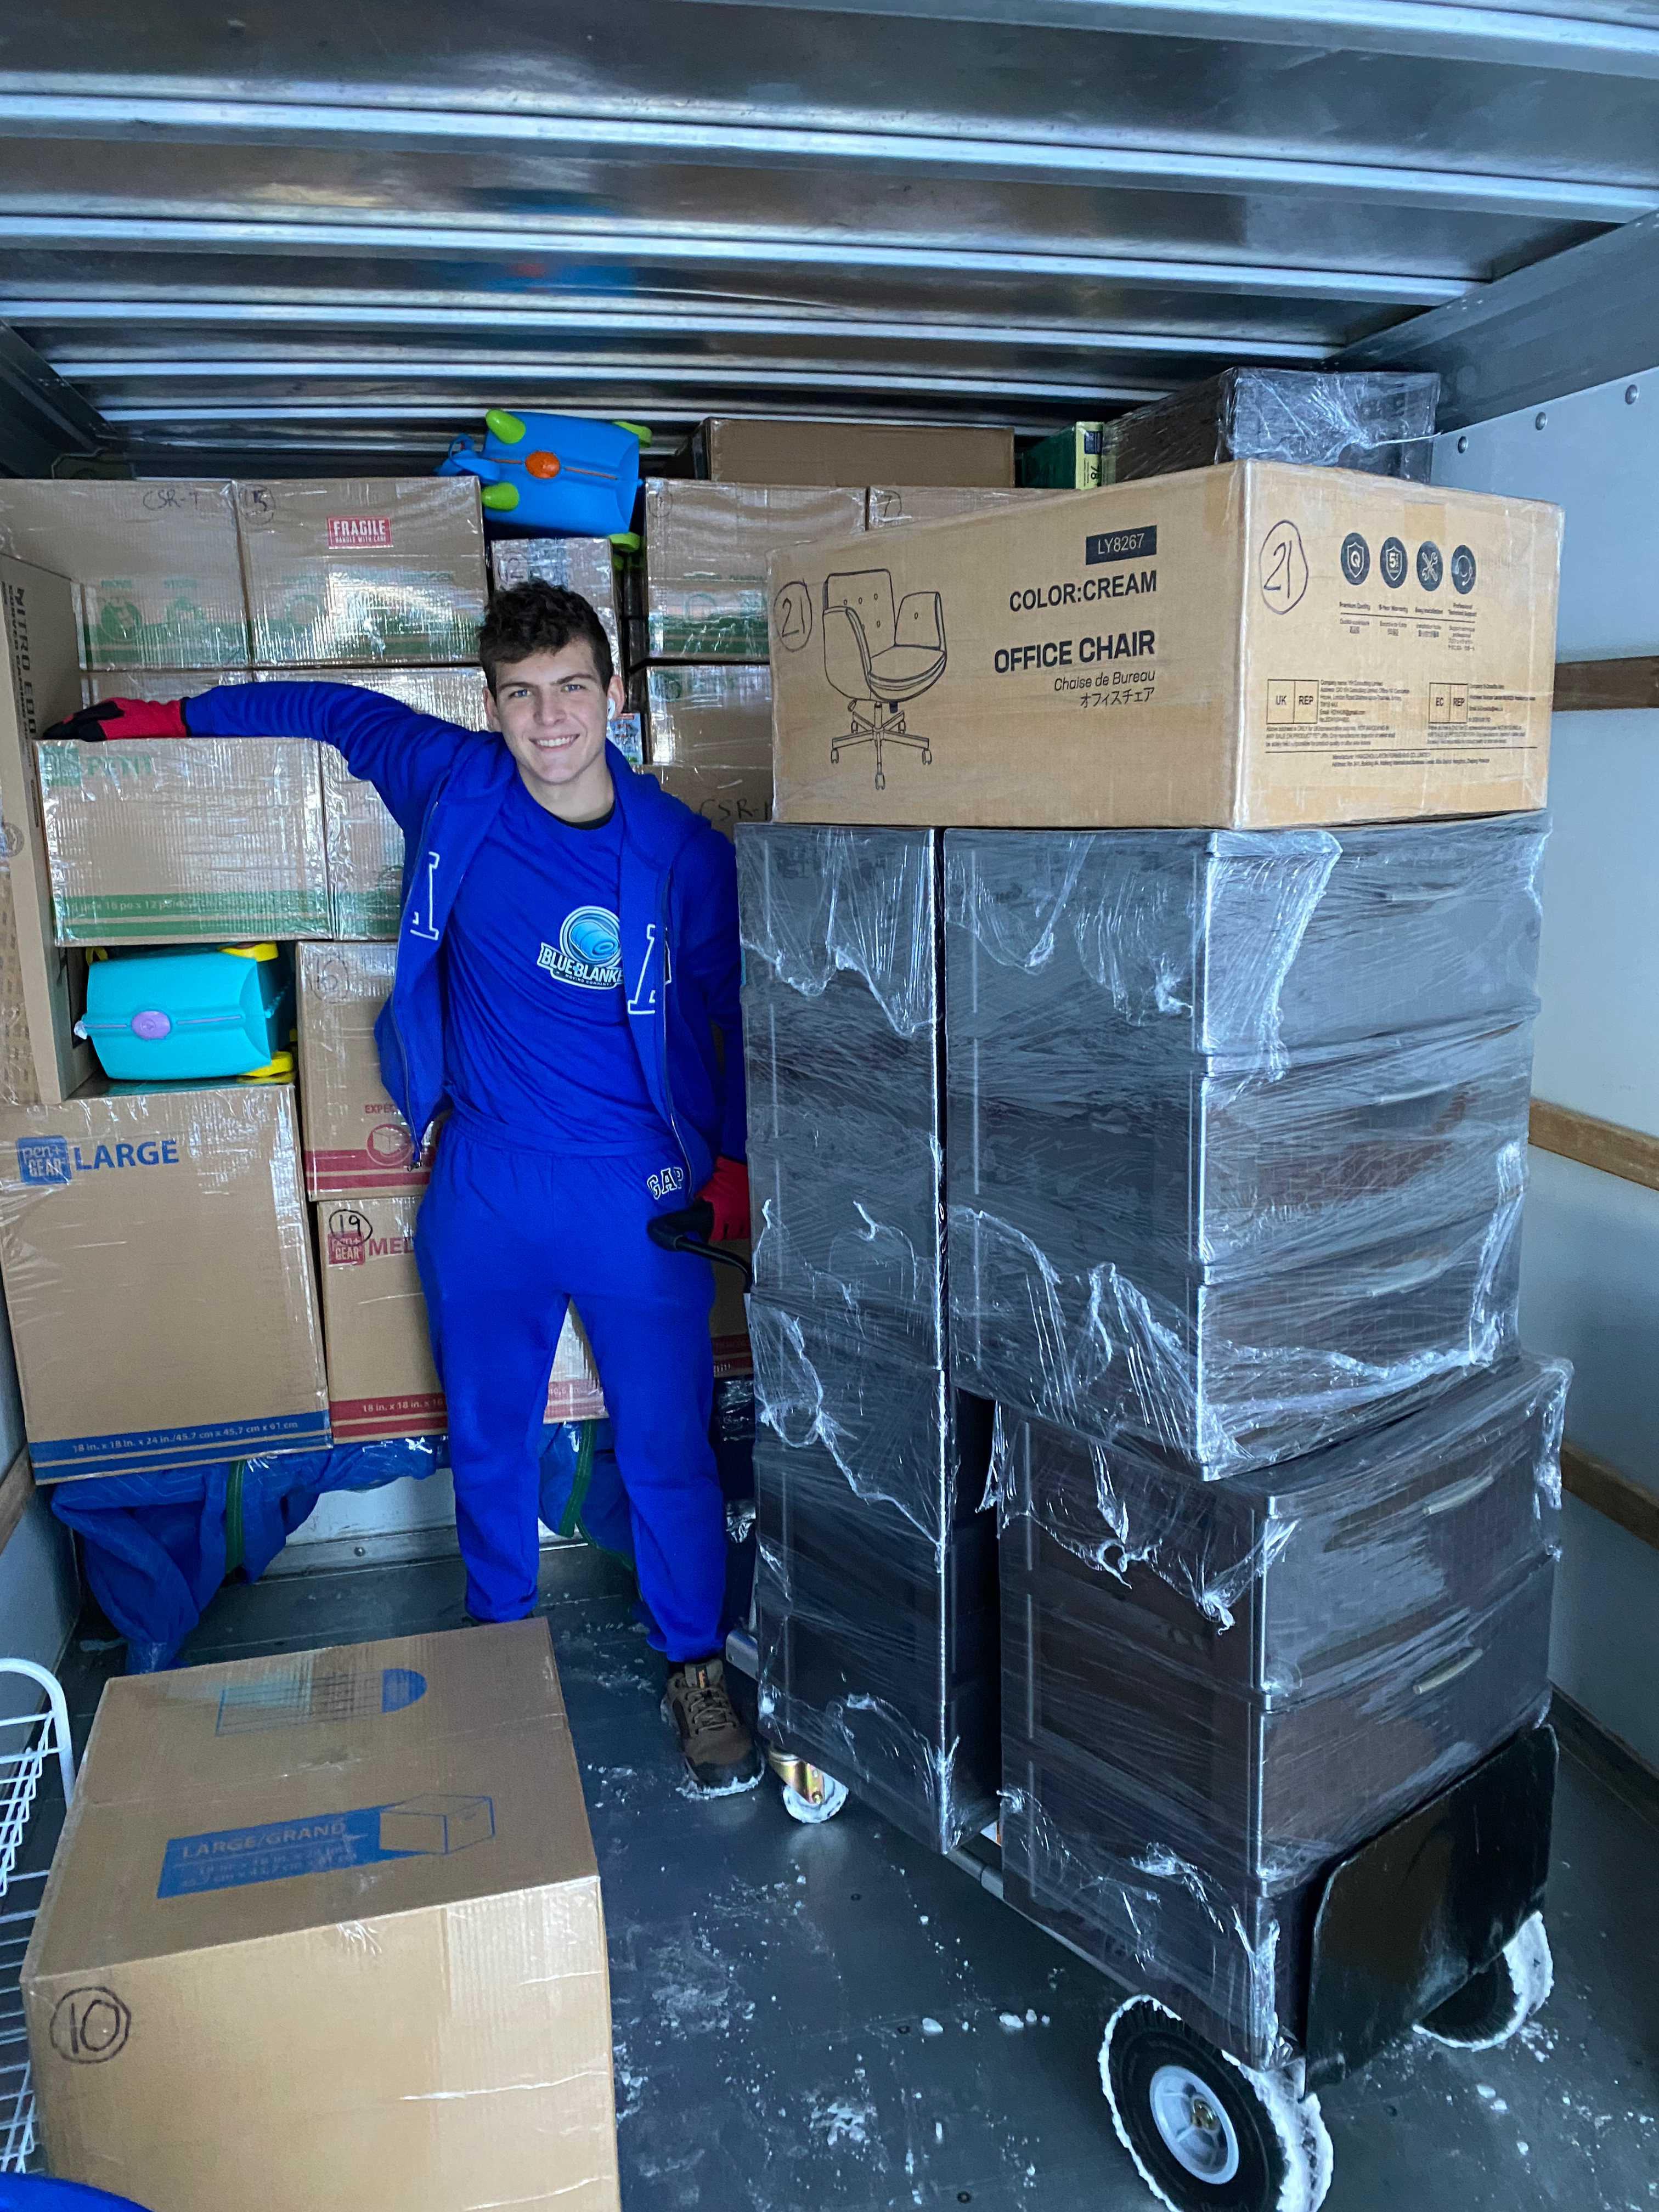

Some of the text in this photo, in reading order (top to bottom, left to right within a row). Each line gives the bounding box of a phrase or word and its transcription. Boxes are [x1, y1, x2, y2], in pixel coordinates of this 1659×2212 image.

[333, 520, 386, 537] FRAGILE
[1098, 533, 1145, 555] LY8267
[1263, 539, 1293, 600] 21
[1009, 570, 1157, 612] COLOR:CREAM
[782, 595, 805, 638] 21
[994, 629, 1155, 674] OFFICE CHAIR
[1054, 670, 1156, 691] Chaise de Bureau
[1080, 686, 1155, 708] オフィスチェア
[1276, 695, 1287, 706] UK
[1299, 695, 1313, 706] REP
[541, 947, 574, 975] BLUE
[29, 1158, 63, 1177] GEAR
[74, 1139, 179, 1171] LARGE
[647, 1166, 684, 1200] GAP
[339, 1214, 362, 1237] 19
[335, 1246, 360, 1260] GEAR
[73, 1444, 84, 1453] 18
[110, 1440, 122, 1448] 18
[182, 1821, 346, 1858] LARGE/GRAND
[70, 1999, 120, 2055] 10
